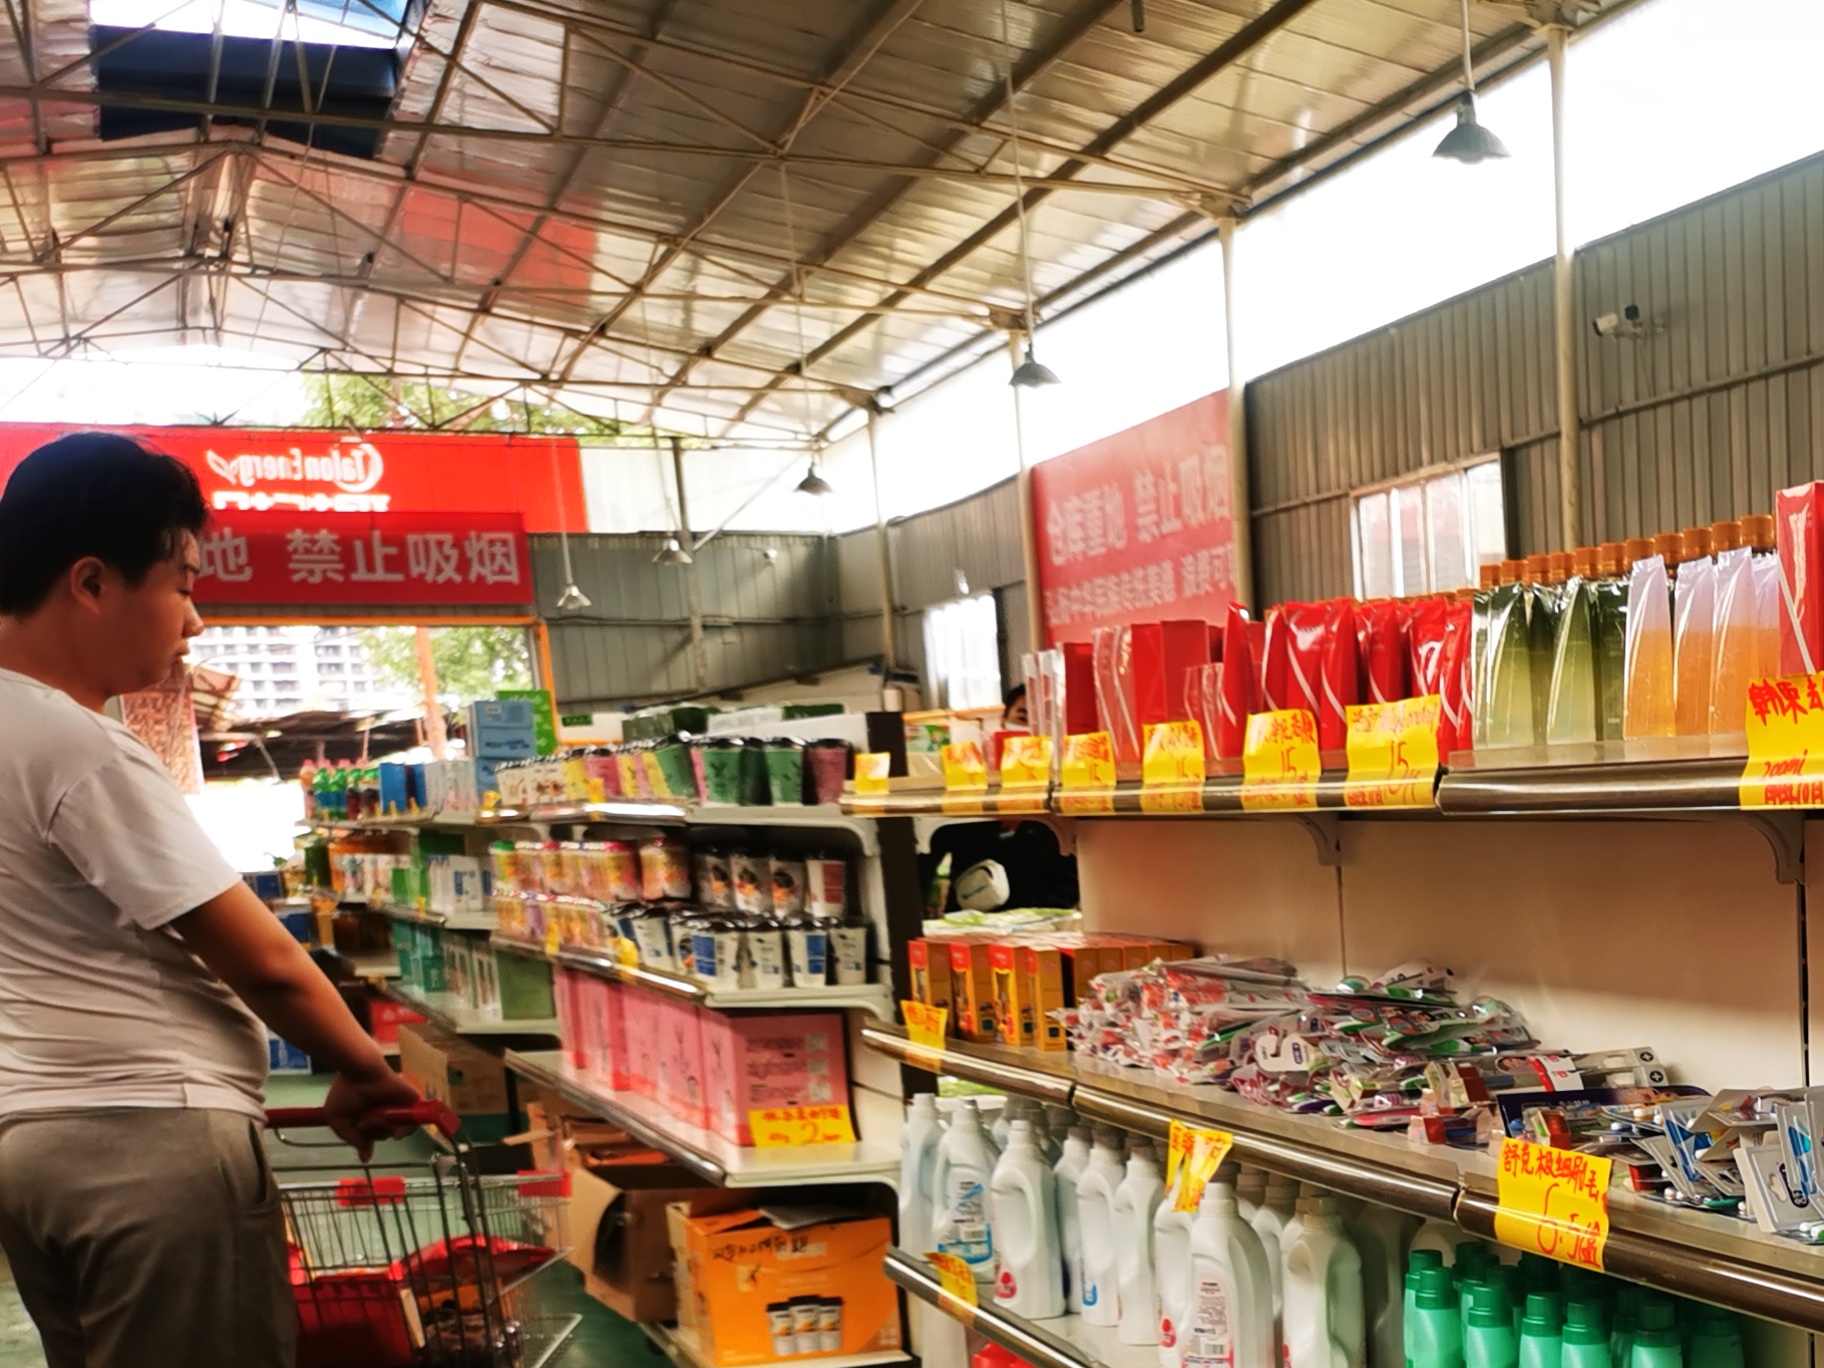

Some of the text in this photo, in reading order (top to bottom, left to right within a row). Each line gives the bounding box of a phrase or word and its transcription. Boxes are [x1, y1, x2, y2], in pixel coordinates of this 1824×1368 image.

[200, 529, 520, 585] 地 禁止吸烟
